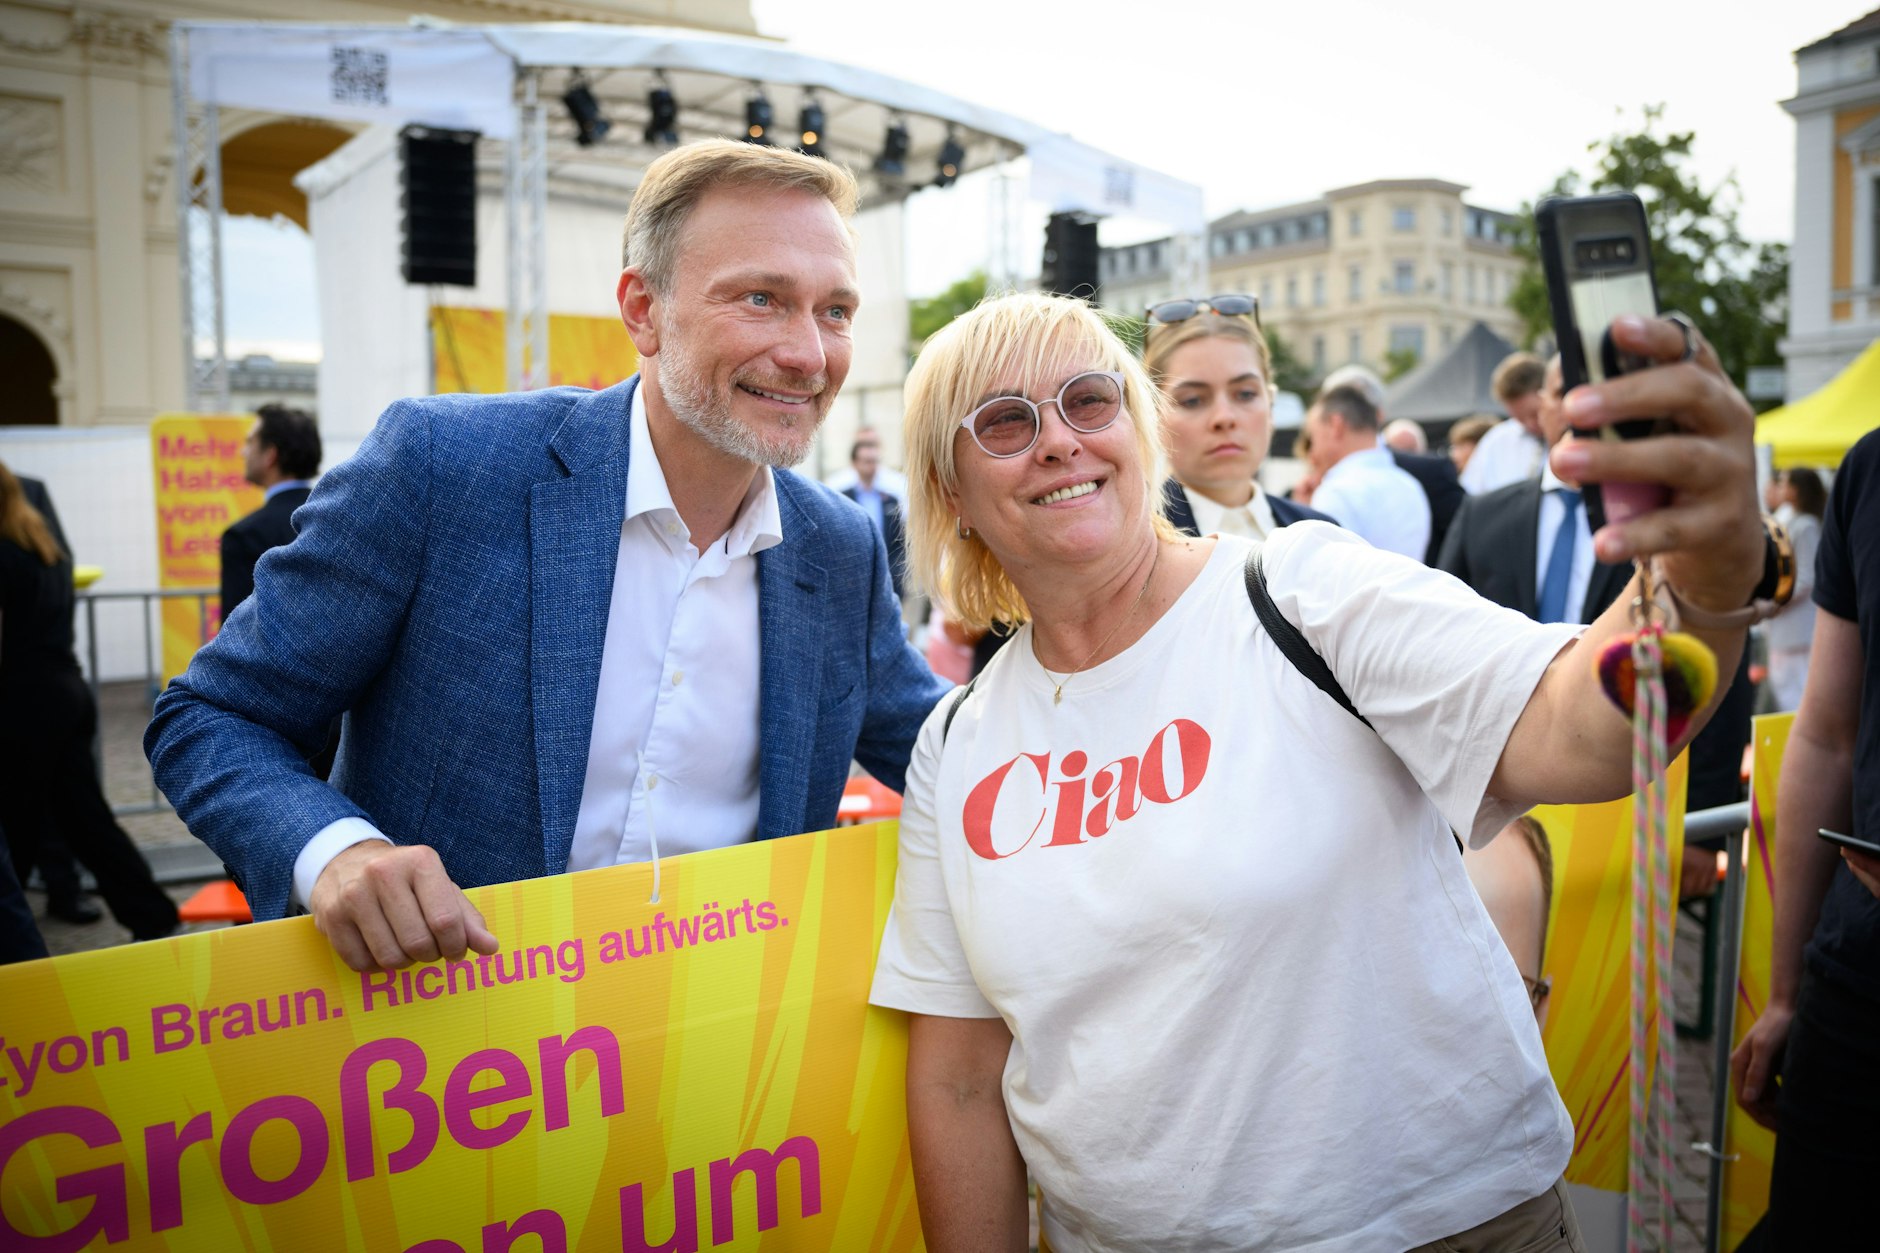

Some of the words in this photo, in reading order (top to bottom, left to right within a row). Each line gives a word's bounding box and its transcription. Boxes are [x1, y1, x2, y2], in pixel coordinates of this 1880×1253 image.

[158, 434, 238, 460] Mehr
[159, 504, 229, 525] vom
[962, 718, 1212, 860] Ciao
[0, 1026, 130, 1098] yon
[151, 986, 345, 1054] Braun.
[360, 939, 586, 1013] Richtung
[598, 898, 790, 964] aufwärts.
[0, 1024, 626, 1253] Großen
[619, 1135, 822, 1253] um
